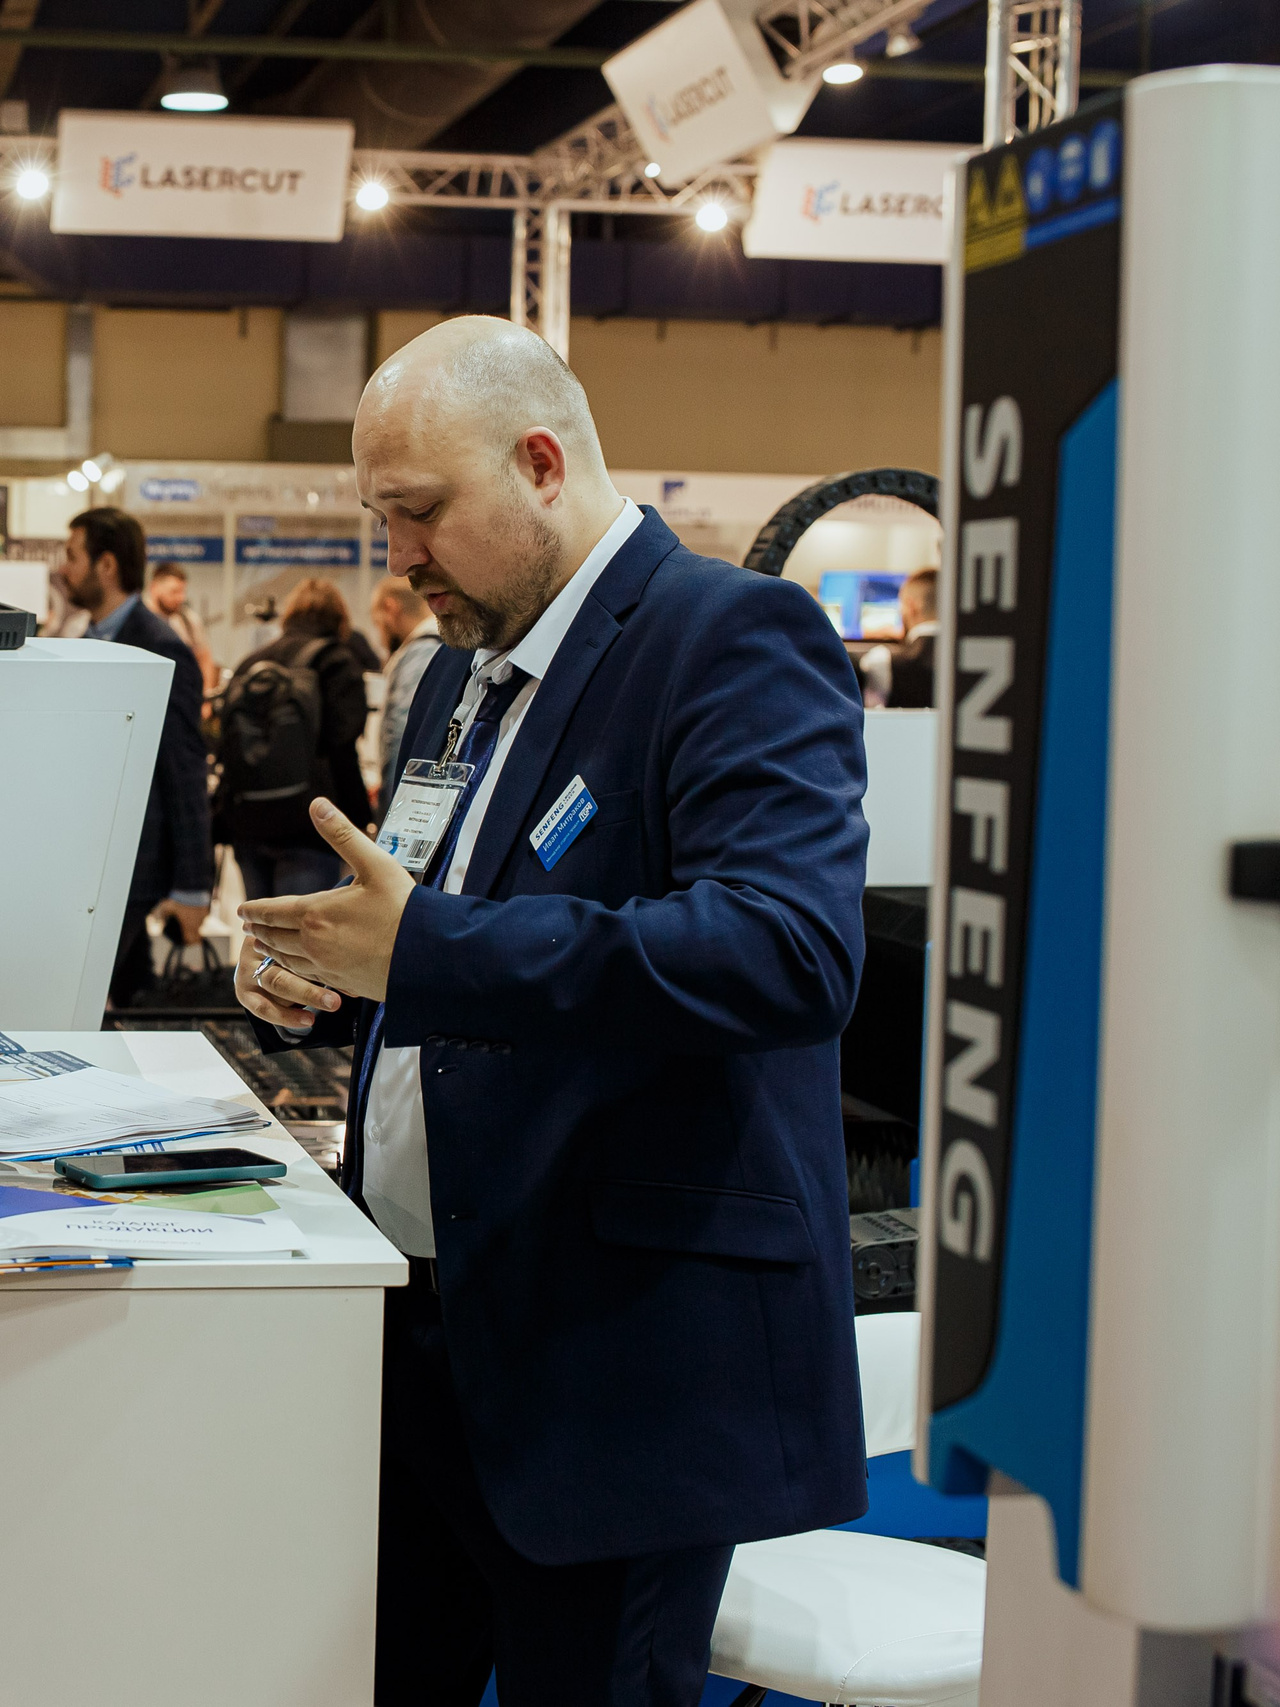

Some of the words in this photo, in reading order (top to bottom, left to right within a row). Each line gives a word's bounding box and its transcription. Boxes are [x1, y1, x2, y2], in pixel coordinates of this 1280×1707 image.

[140, 163, 304, 195] LASERCUT
[535, 802, 565, 841] SENFENG
[542, 832, 559, 852] Иван
[556, 797, 586, 833] Митраков
[940, 394, 1024, 1265] SENFENG
[66, 1224, 214, 1234] ПРОДУКЦИИ
[92, 1219, 178, 1227] КАТАЛОГ
